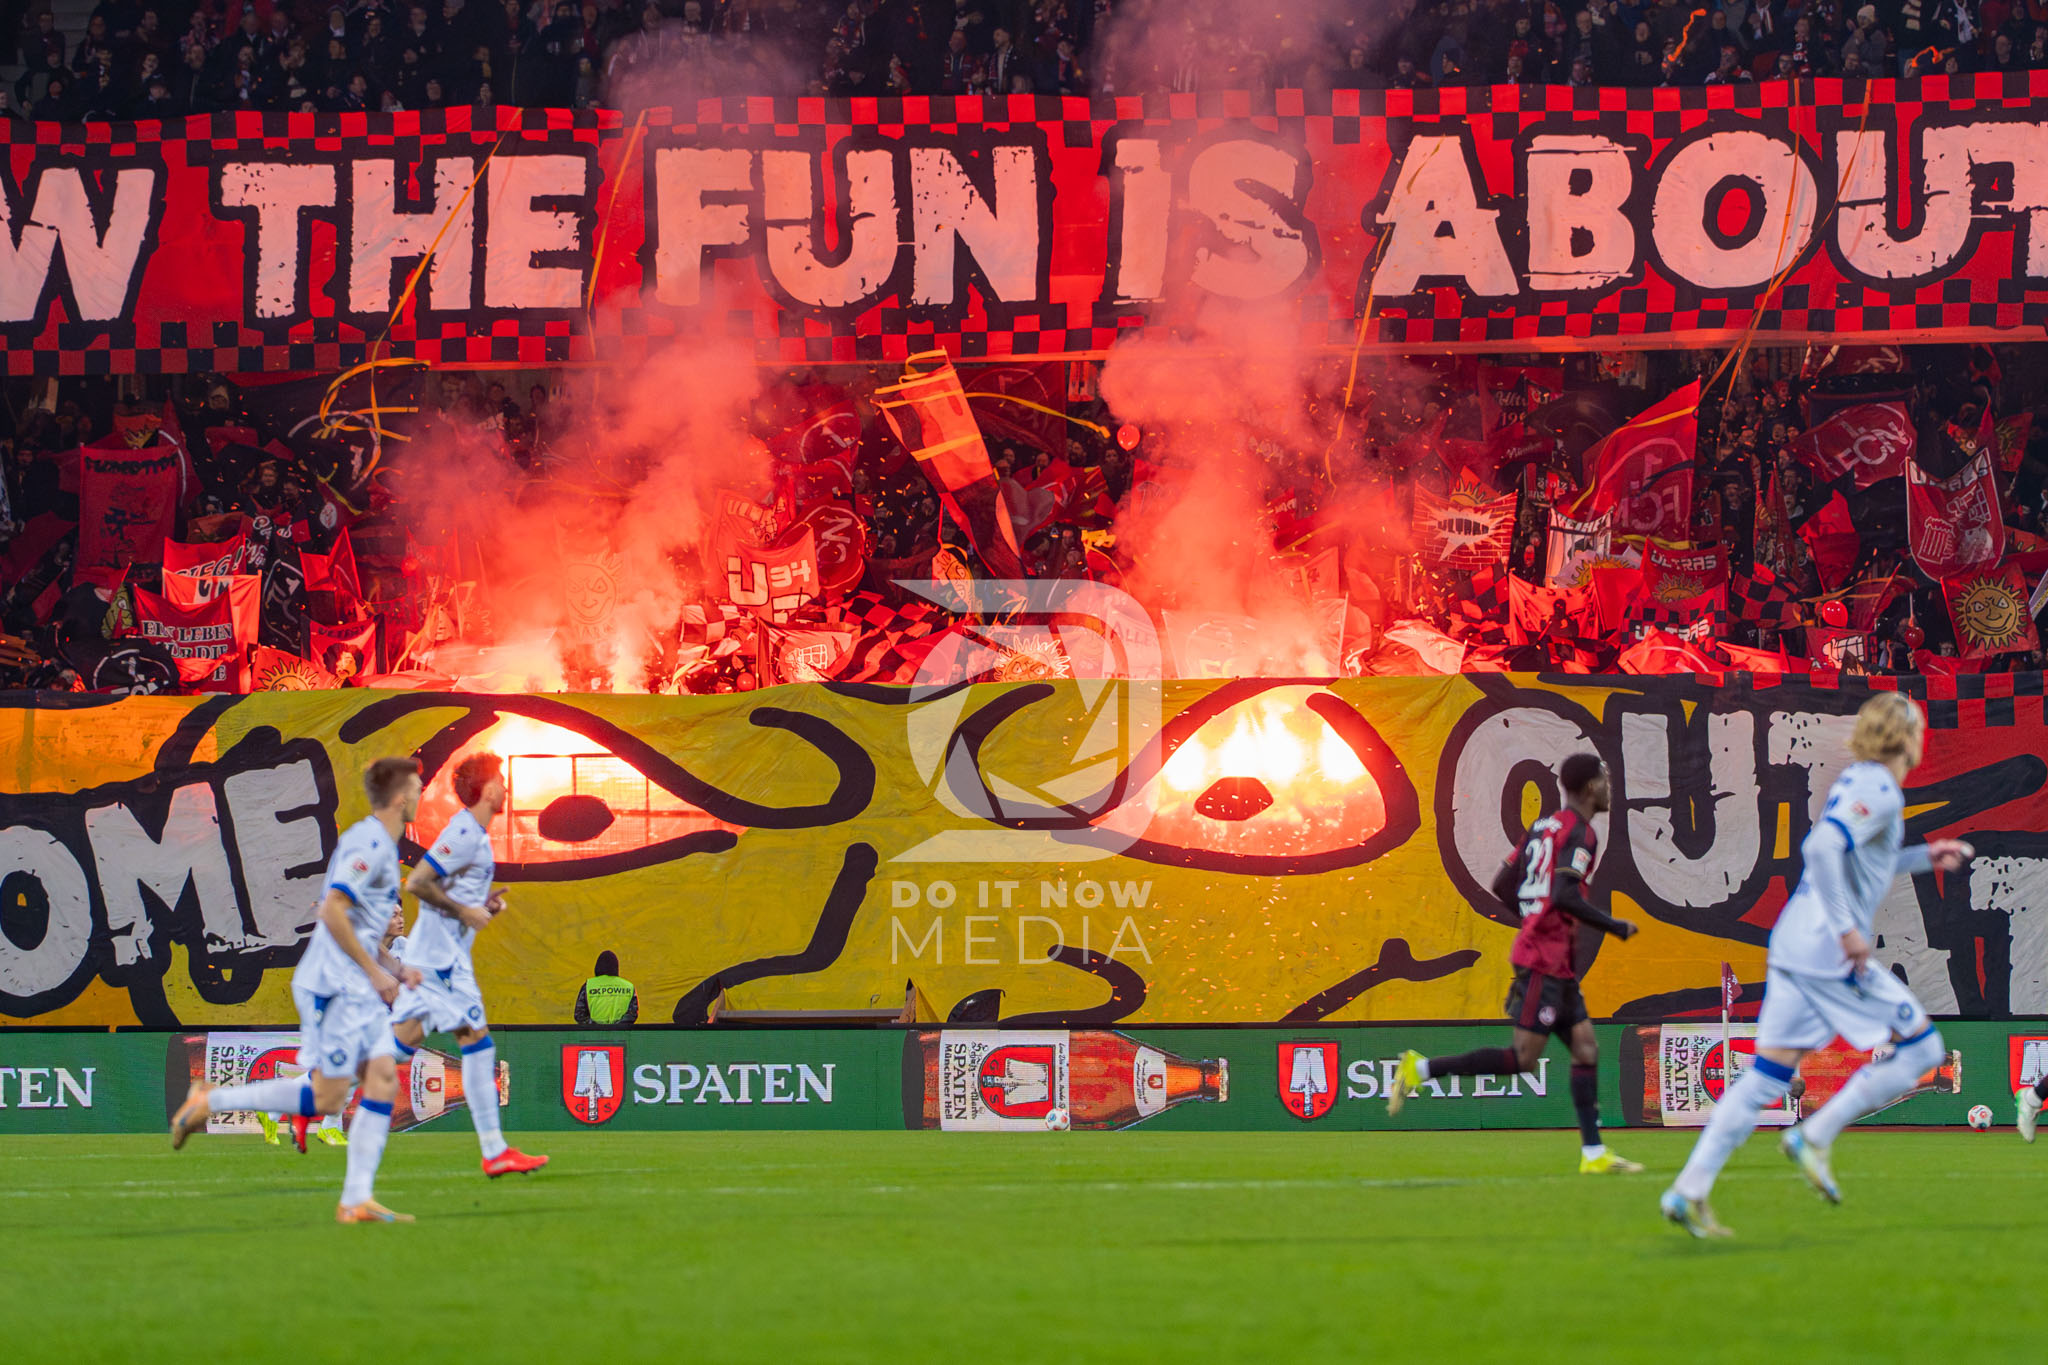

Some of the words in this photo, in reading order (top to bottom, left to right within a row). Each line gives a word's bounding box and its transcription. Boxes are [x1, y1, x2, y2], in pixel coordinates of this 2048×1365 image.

[221, 155, 587, 319] THE
[655, 145, 1037, 308] FUN
[1114, 138, 1308, 305] IS
[178, 623, 233, 643] LEBEN
[602, 987, 631, 995] POWER
[220, 1046, 235, 1125] SPAN
[633, 1063, 837, 1105] SPATEN
[944, 1043, 953, 1097] Münchner
[953, 1043, 968, 1120] SPATEN
[1664, 1037, 1674, 1091] Münchner
[1674, 1037, 1690, 1112] SPATEN
[944, 1101, 953, 1120] Hell
[1665, 1093, 1675, 1112] Hell
